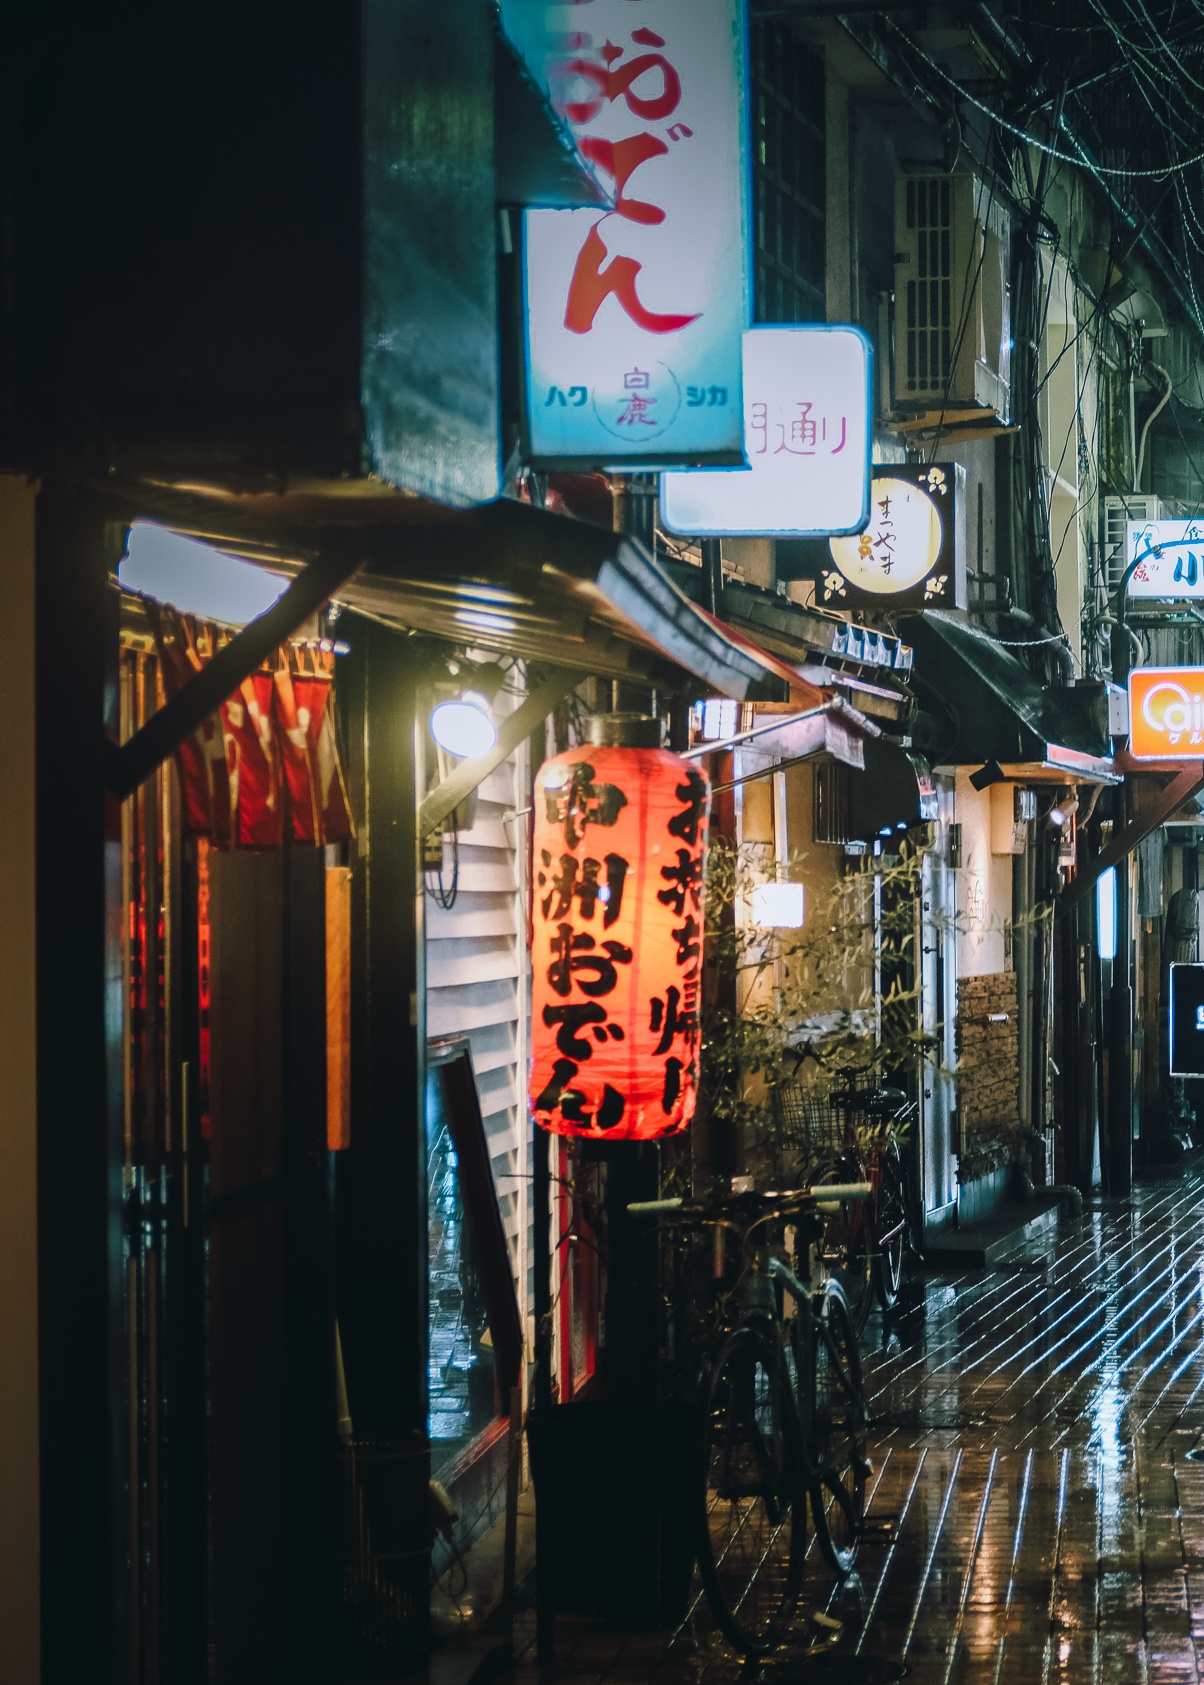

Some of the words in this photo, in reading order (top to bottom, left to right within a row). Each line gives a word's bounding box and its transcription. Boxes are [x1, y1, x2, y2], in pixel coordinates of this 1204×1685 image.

[545, 385, 588, 408] ハク
[685, 385, 729, 408] シカ
[616, 366, 658, 426] 白鹿
[873, 494, 897, 575] まつやま
